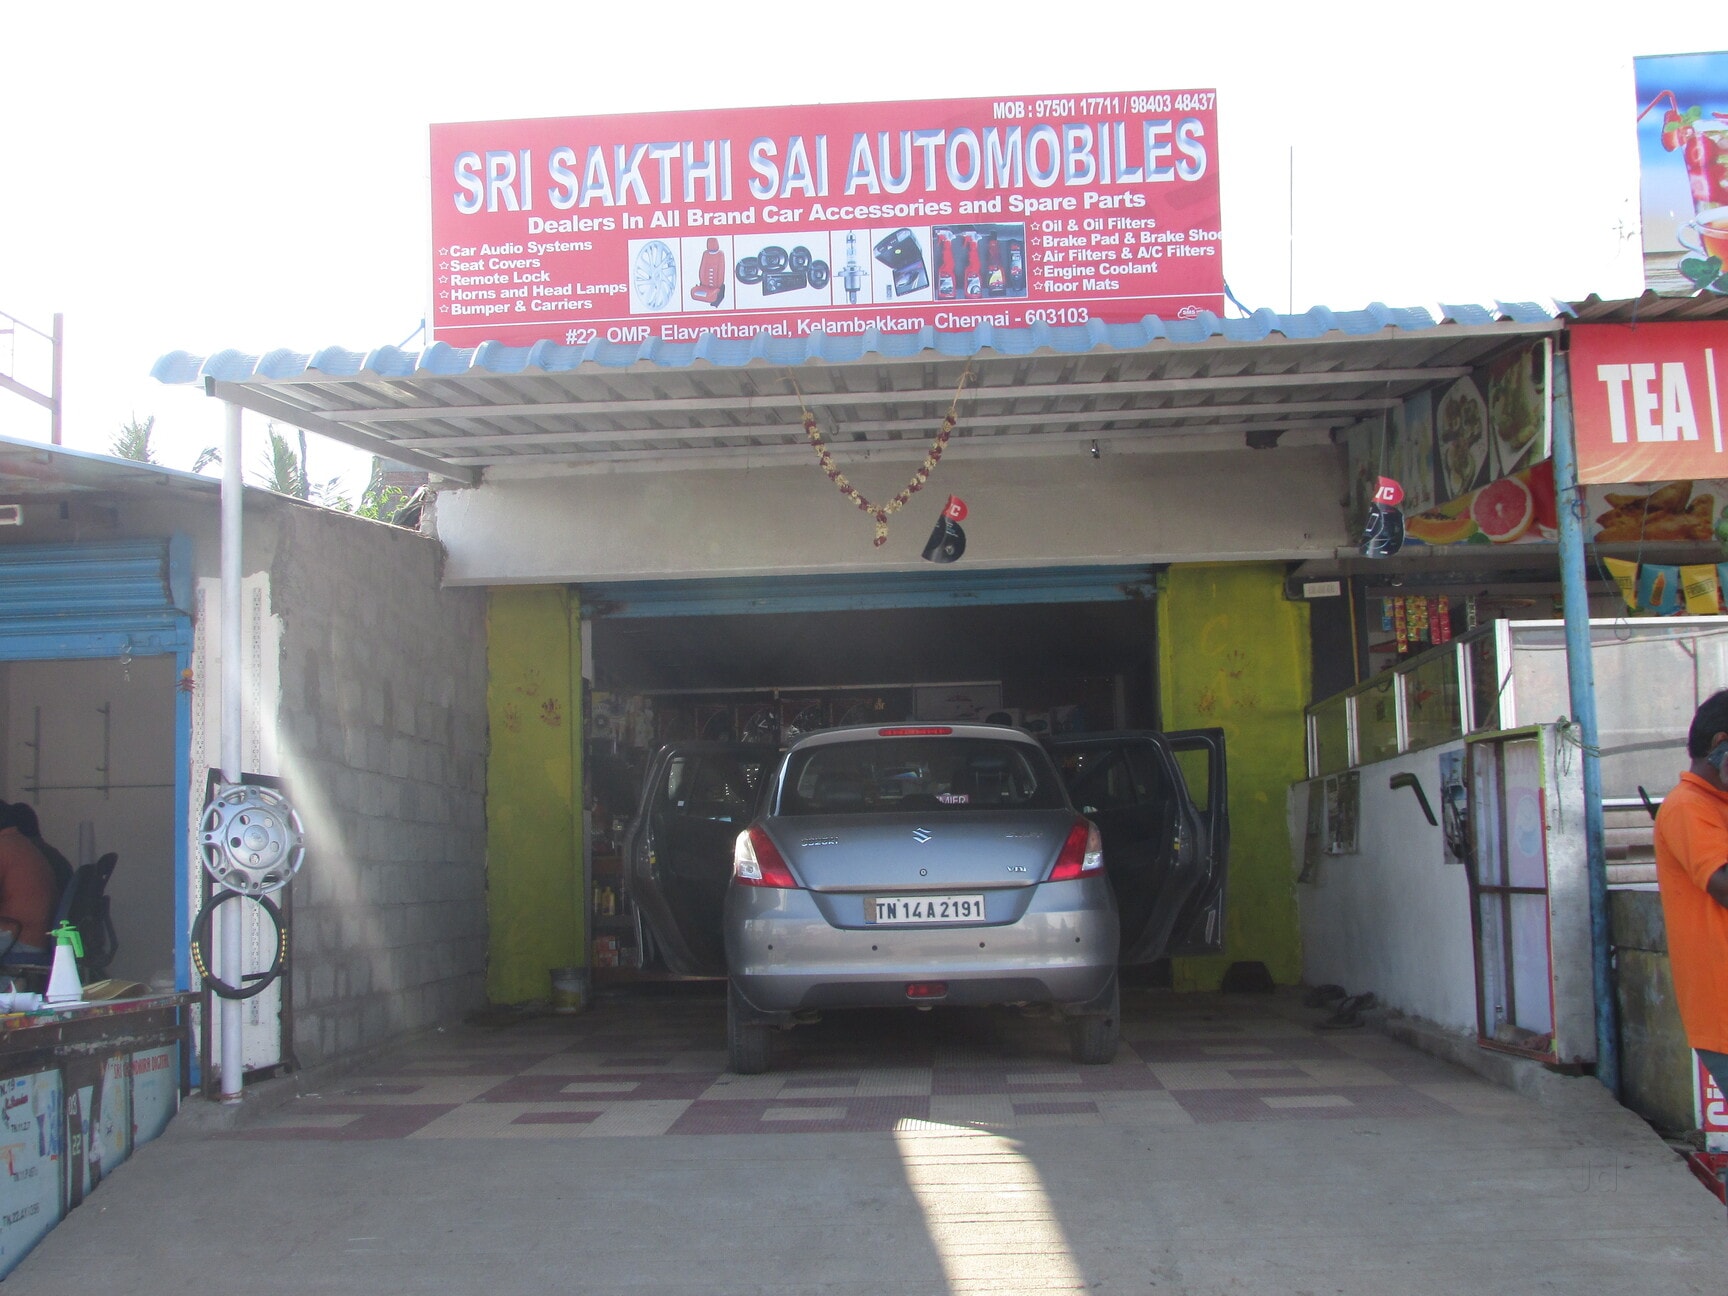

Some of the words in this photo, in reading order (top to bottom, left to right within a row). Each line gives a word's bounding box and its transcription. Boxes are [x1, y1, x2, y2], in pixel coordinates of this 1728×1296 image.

[993, 102, 1025, 119] MOB
[1036, 99, 1075, 117] 97501
[1080, 96, 1119, 115] 17711
[1123, 96, 1128, 114] /
[1130, 95, 1171, 113] 98403
[1175, 92, 1216, 111] 48437
[453, 148, 532, 214] SRI
[548, 139, 732, 210] SAKTHI
[749, 134, 829, 200] SAI
[844, 117, 1208, 196] AUTOMOBILES
[528, 214, 615, 234] Dealers
[622, 212, 643, 229] In
[650, 210, 680, 228] All
[687, 207, 755, 227] Brand
[762, 206, 803, 223] Car
[808, 198, 952, 221] Accessories
[959, 196, 1002, 215] and
[1009, 193, 1077, 216] Spare
[1084, 190, 1147, 209] Parts
[1042, 219, 1062, 232] Oil
[1067, 219, 1079, 231] &
[1083, 218, 1103, 231] Oil
[1108, 217, 1156, 230] Filters
[1043, 235, 1086, 247] Brake
[1091, 233, 1119, 246] Pad
[1124, 232, 1136, 244] &
[1141, 231, 1185, 243] Brake
[450, 245, 476, 257] Car
[480, 242, 523, 255] Audio
[528, 240, 592, 255] Systems
[1043, 250, 1065, 262] Air
[1069, 248, 1117, 261] Filters
[1121, 247, 1133, 259] &
[1137, 246, 1162, 259] A/C
[1167, 244, 1215, 257] Filters
[450, 260, 484, 272] Seat
[489, 258, 541, 270] Covers
[1044, 265, 1095, 279] Engine
[1099, 262, 1157, 275] Coolant
[451, 274, 509, 286] Remote
[513, 270, 550, 283] Lock
[1044, 280, 1079, 292] floor
[1083, 278, 1120, 291] Mats
[451, 288, 496, 300] Horns
[501, 286, 528, 298] and
[532, 284, 572, 296] Head
[576, 282, 627, 296] Lamps
[451, 302, 510, 316] Bumper
[515, 301, 526, 312] &
[531, 298, 593, 311] Carriers
[565, 328, 598, 345] #22
[607, 326, 651, 343] OMR
[1025, 308, 1088, 325] 603103
[1597, 362, 1699, 444] TEA
[876, 902, 897, 919] TN
[903, 902, 922, 919] 14
[927, 901, 936, 918] A
[940, 900, 981, 918] 2191
